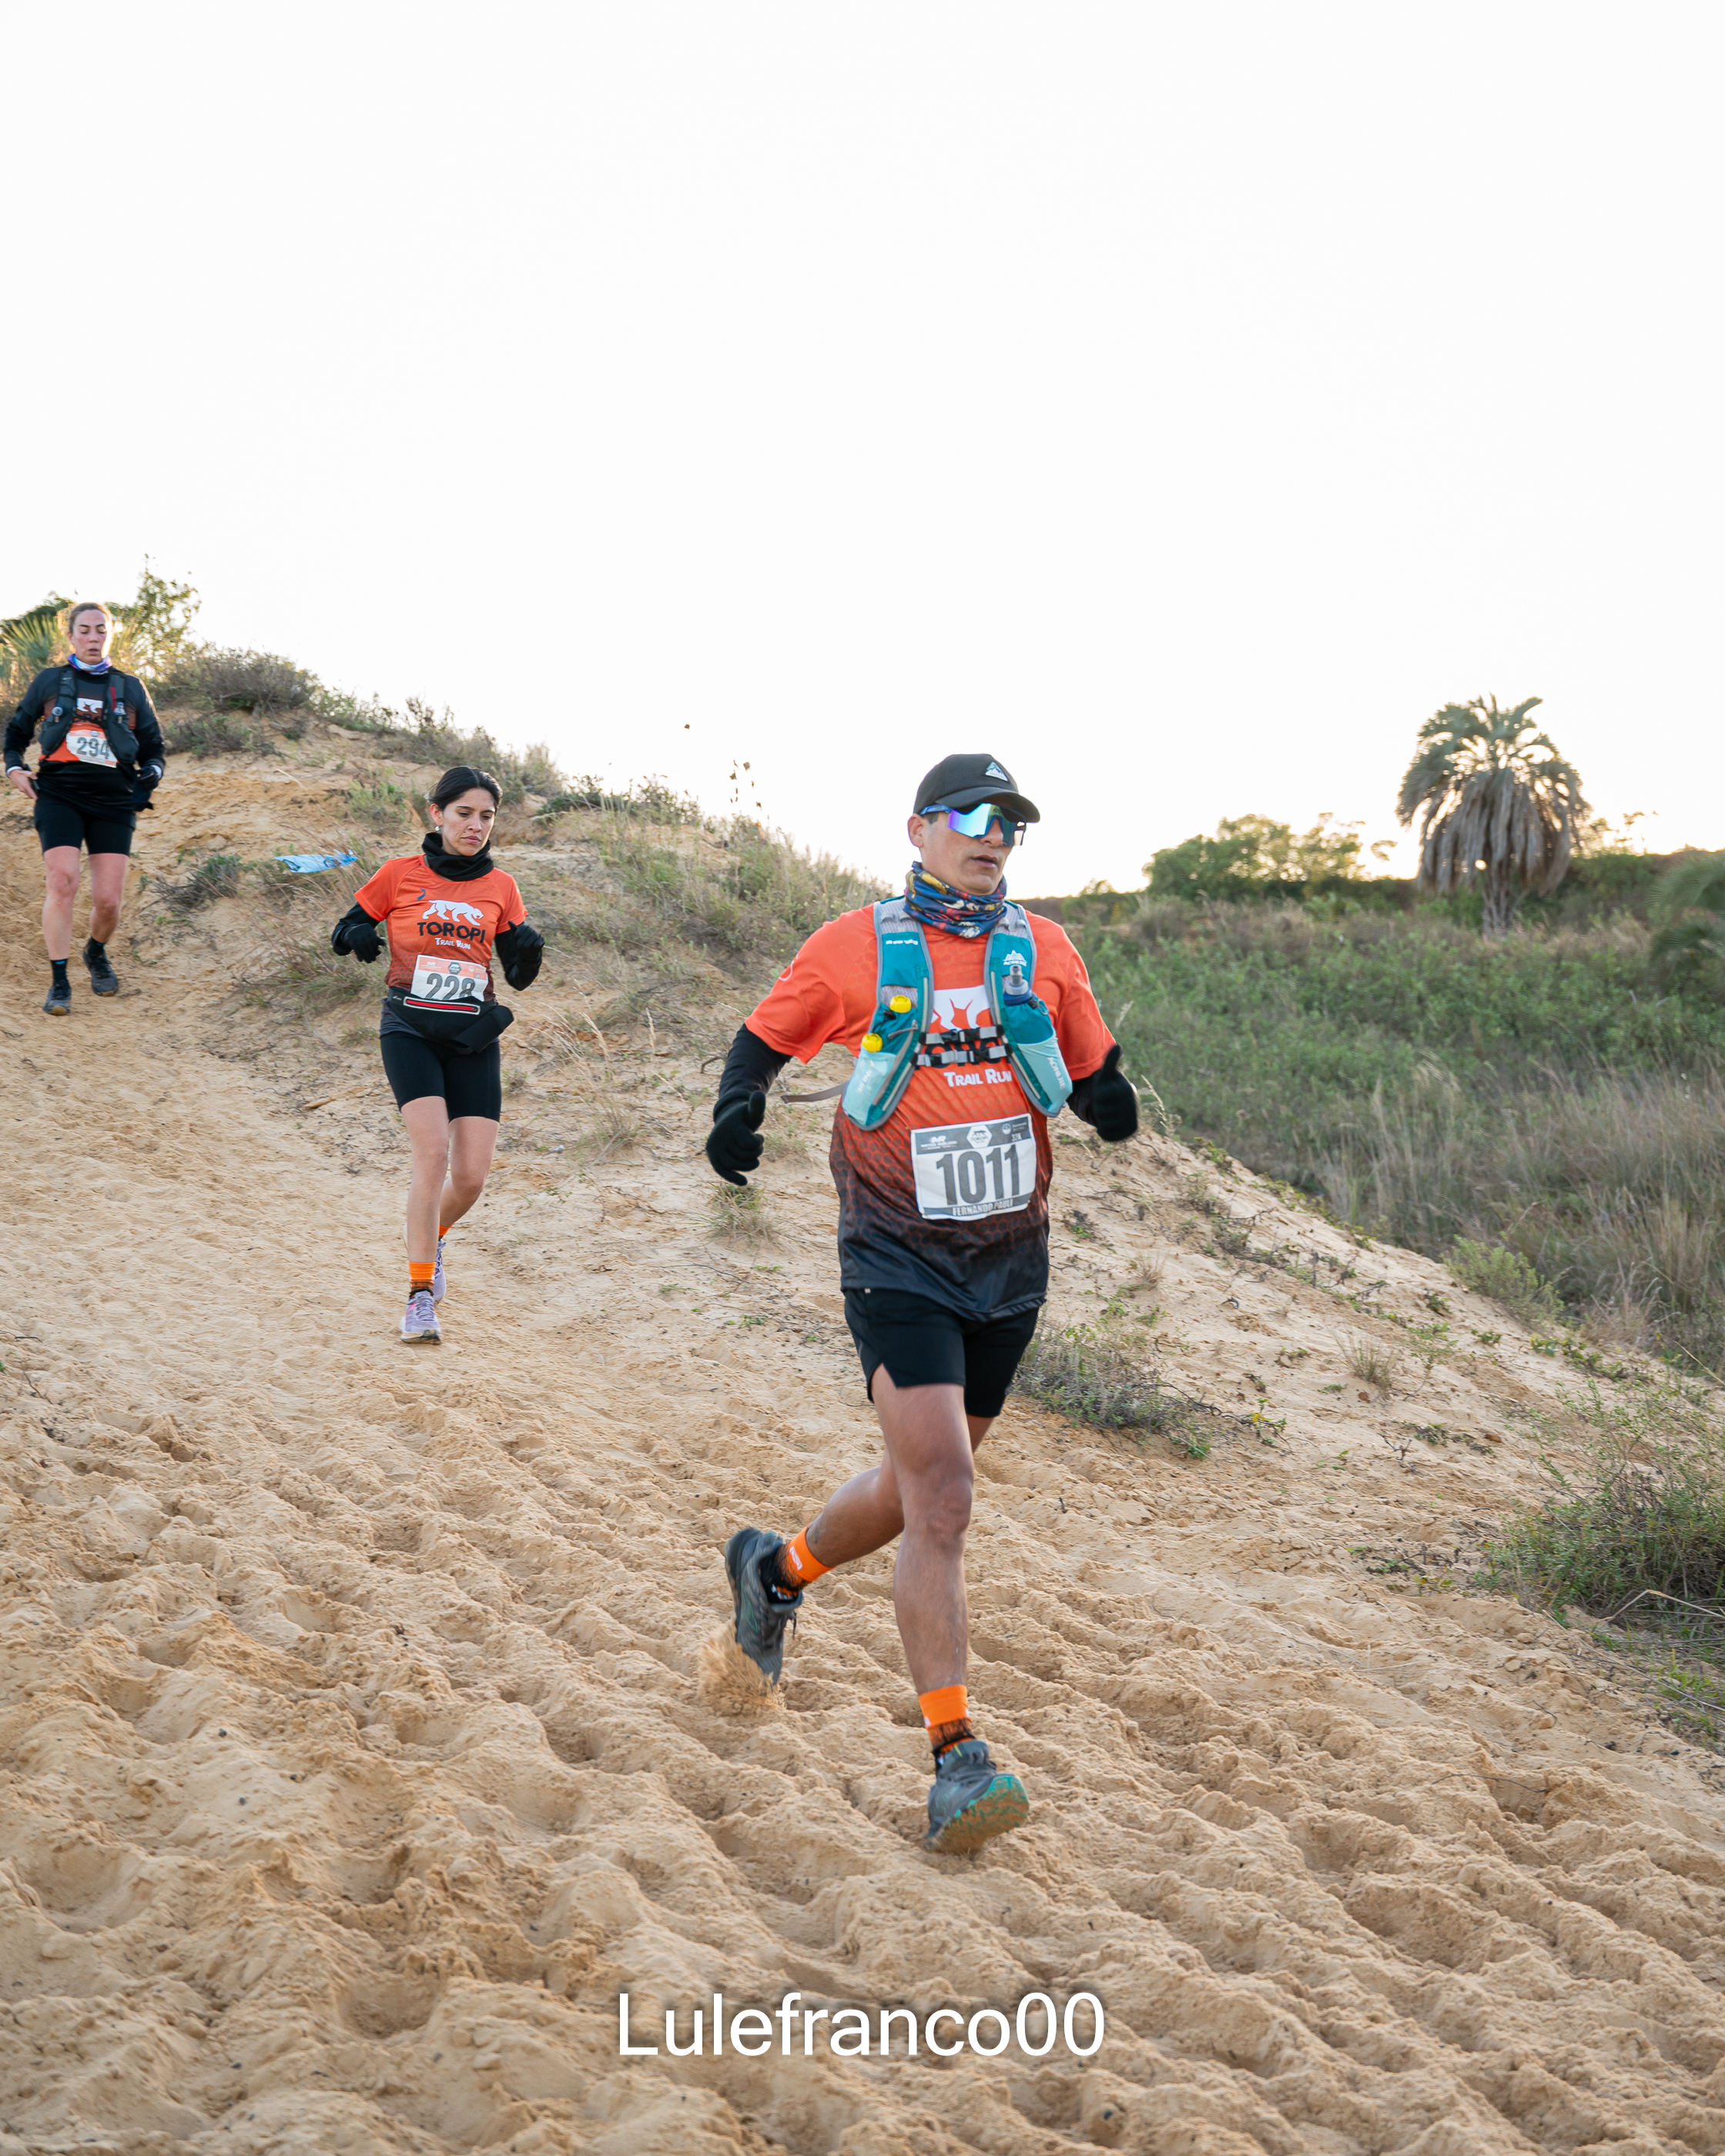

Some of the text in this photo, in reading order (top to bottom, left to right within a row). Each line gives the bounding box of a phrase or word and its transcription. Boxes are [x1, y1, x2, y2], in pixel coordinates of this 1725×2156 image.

[77, 737, 109, 759] 294
[417, 922, 486, 943] TOROPI
[426, 973, 476, 1000] 228
[943, 1071, 983, 1087] TRAIL
[936, 1143, 1020, 1206] 1011
[952, 1203, 993, 1217] FERNANDO
